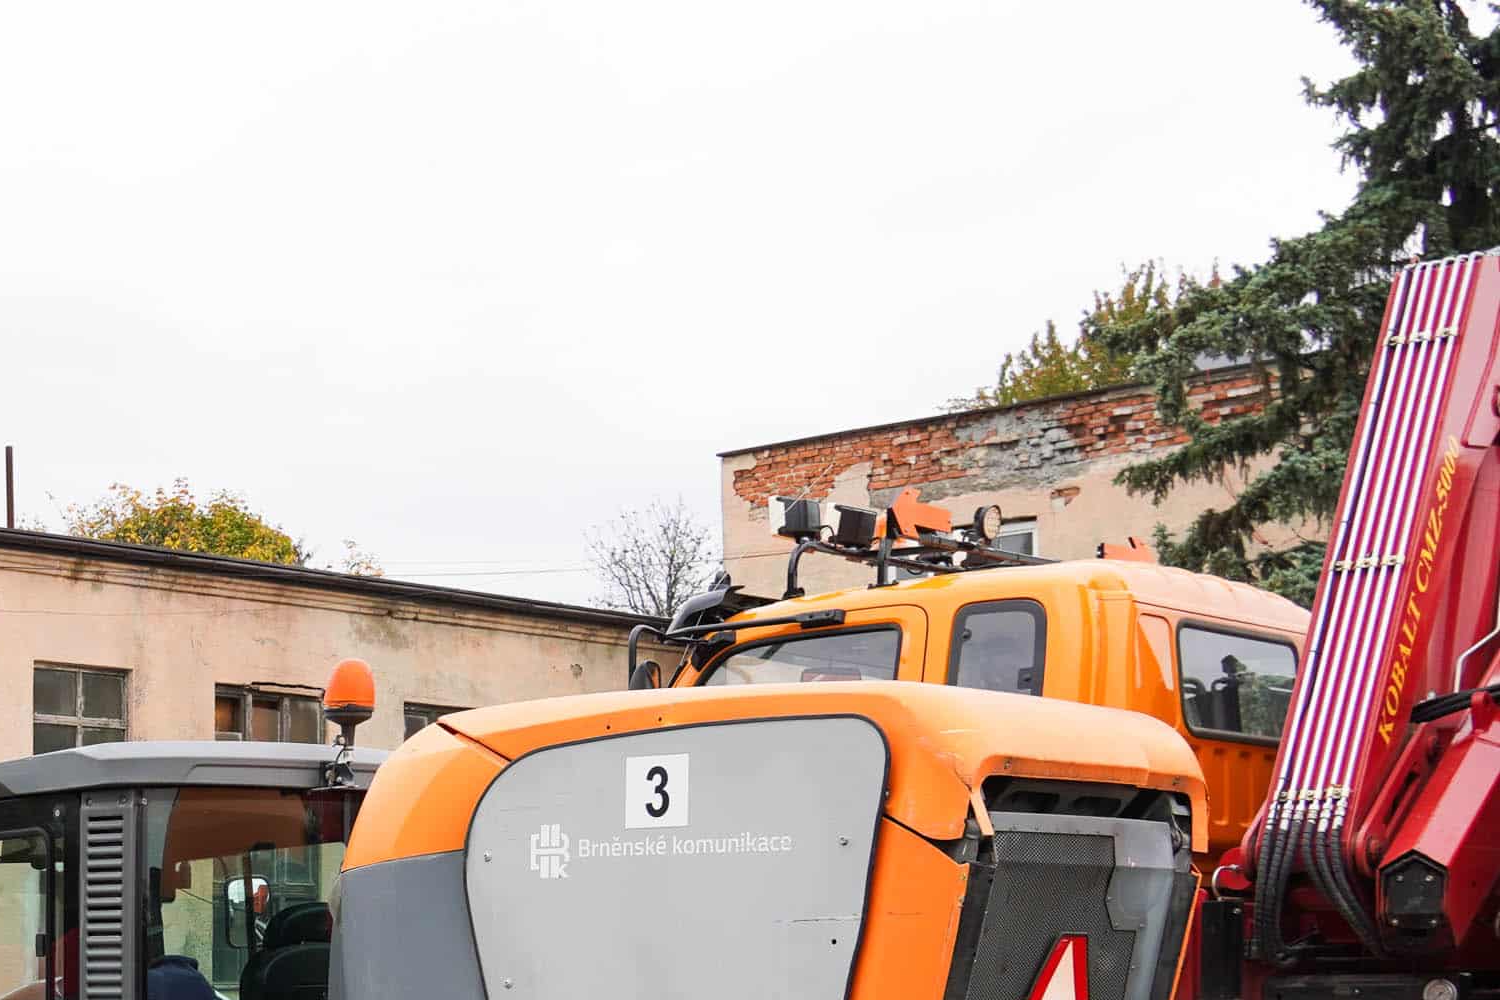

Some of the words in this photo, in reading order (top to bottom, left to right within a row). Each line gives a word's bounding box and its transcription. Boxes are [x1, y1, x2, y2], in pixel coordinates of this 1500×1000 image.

[1378, 592, 1421, 744] KOBALT
[1415, 434, 1460, 593] CMZ-5000
[645, 765, 670, 818] 3
[578, 836, 666, 858] Brněnské
[672, 831, 792, 855] komunikace
